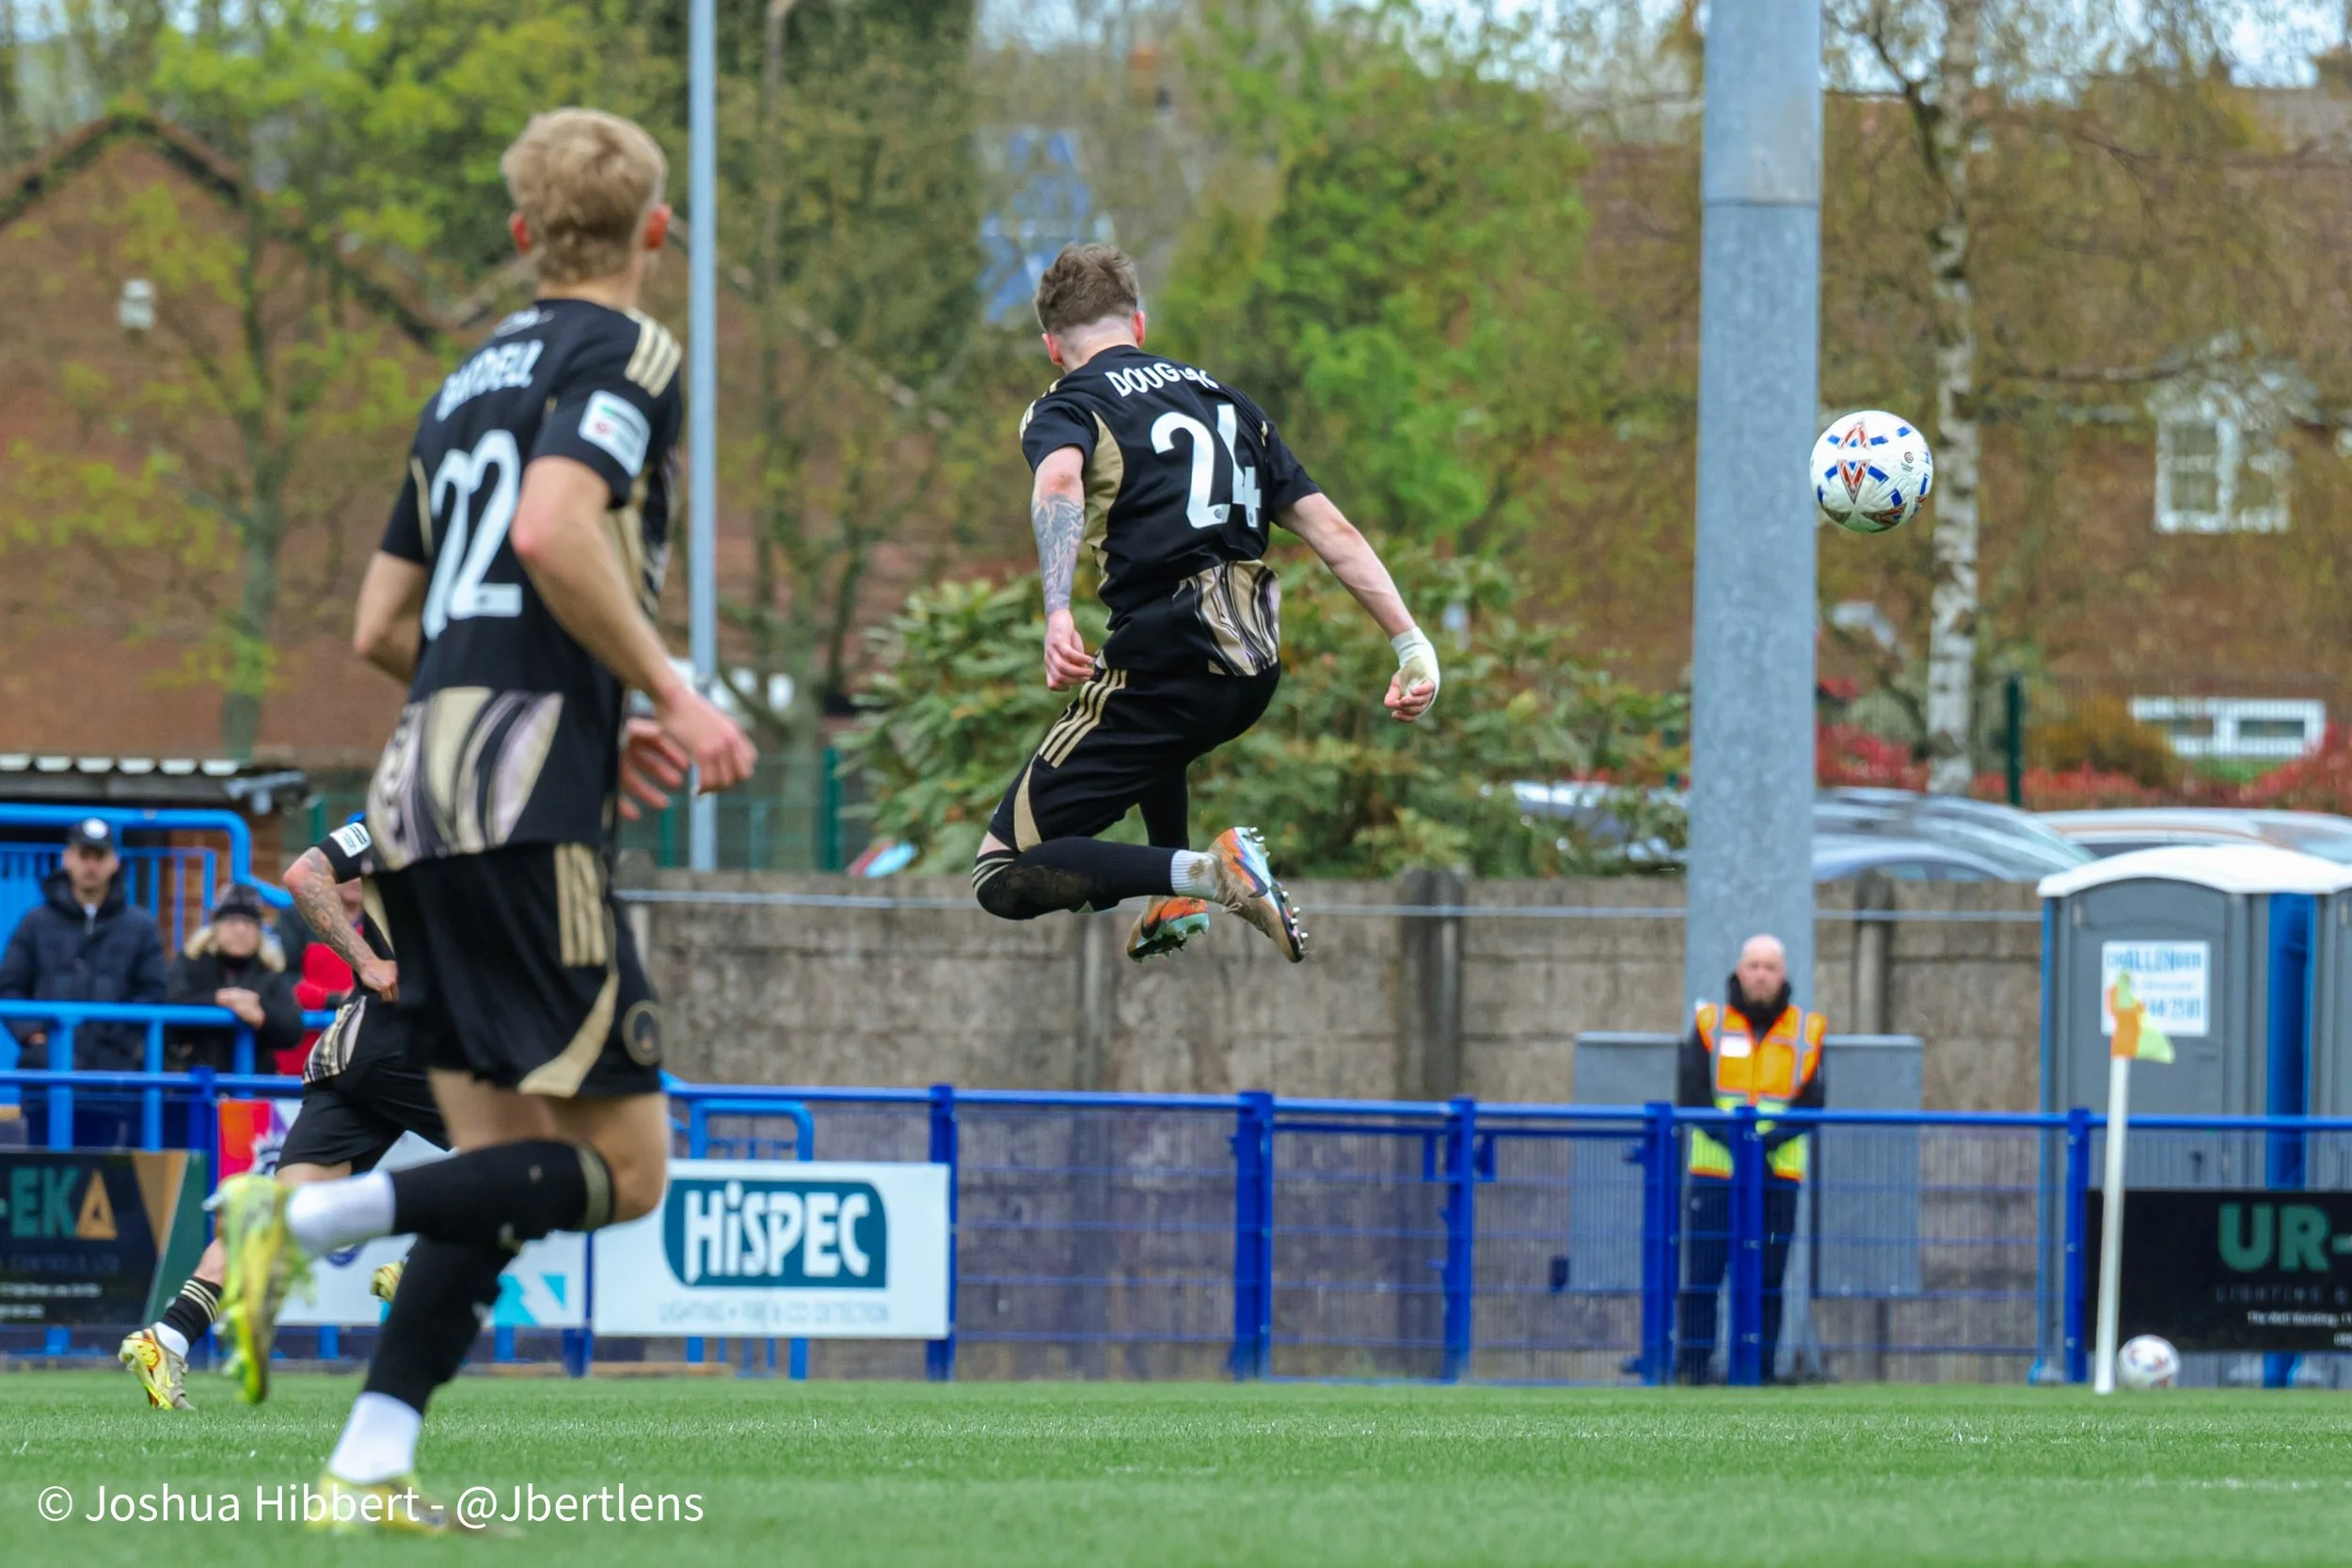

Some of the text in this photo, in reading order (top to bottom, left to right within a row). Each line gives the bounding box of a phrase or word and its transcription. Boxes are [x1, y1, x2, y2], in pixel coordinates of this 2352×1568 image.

[1151, 404, 1262, 529] 24
[422, 429, 523, 641] 22
[0, 1167, 119, 1241] EKA
